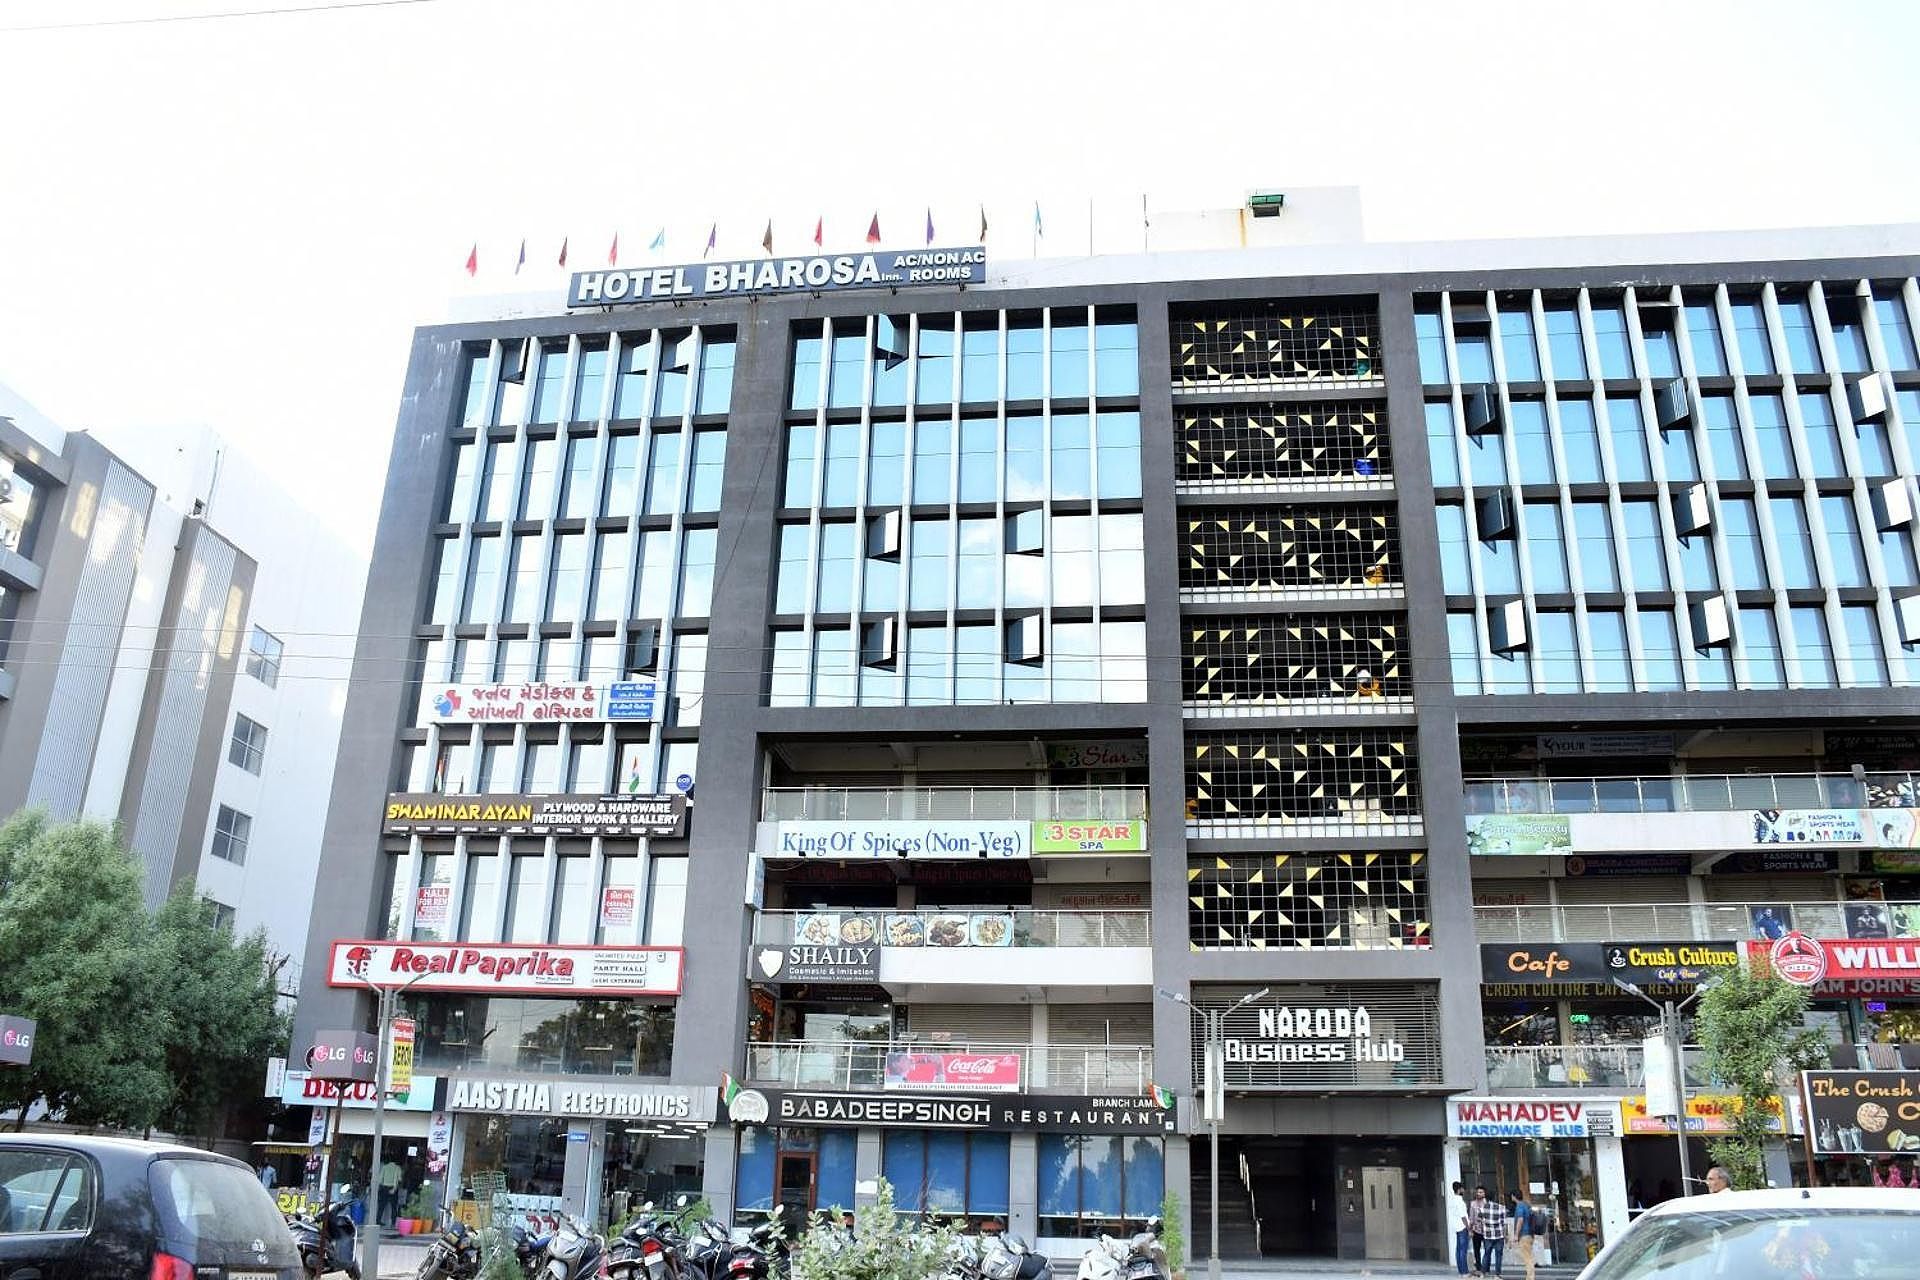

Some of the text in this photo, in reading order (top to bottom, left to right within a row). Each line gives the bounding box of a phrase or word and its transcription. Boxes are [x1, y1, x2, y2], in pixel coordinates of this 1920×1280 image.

[577, 268, 693, 301] HOTEL
[704, 255, 881, 292] BHAROSA
[909, 266, 971, 282] ROOMS
[543, 803, 672, 813] PLYWOOD & HARDWARE
[532, 813, 680, 825] INTERIOR WORK & GALLERY
[1067, 825, 1131, 841] STAR
[783, 829, 1021, 856] King Of Spices (Non-Veg)
[1079, 840, 1104, 851] SPA
[789, 946, 874, 965] SHAILY
[1628, 947, 1738, 967] Crush Culture
[1832, 946, 1920, 969] WILL
[390, 947, 574, 982] Real Paprika
[1508, 951, 1571, 978] Cafe
[1658, 969, 1677, 981] Cafe
[1485, 983, 1527, 998] CRUSH
[1532, 983, 1590, 998] CULTURE
[1259, 1007, 1371, 1038] NARODA
[16, 1036, 29, 1048] LG
[1224, 1039, 1404, 1062] Business Hub
[329, 1047, 346, 1060] LG
[363, 1050, 374, 1064] LG
[1812, 1077, 1913, 1097] The Crush
[452, 1080, 689, 1118] AASTHA ELECTRONICS
[1092, 1098, 1130, 1108] BRANCH
[781, 1099, 991, 1123] BABADEEPSINGH
[1004, 1110, 1165, 1125] RESTAURANT
[1458, 1103, 1582, 1122] MAHADEV
[1460, 1124, 1585, 1137] HARDWARE HUB
